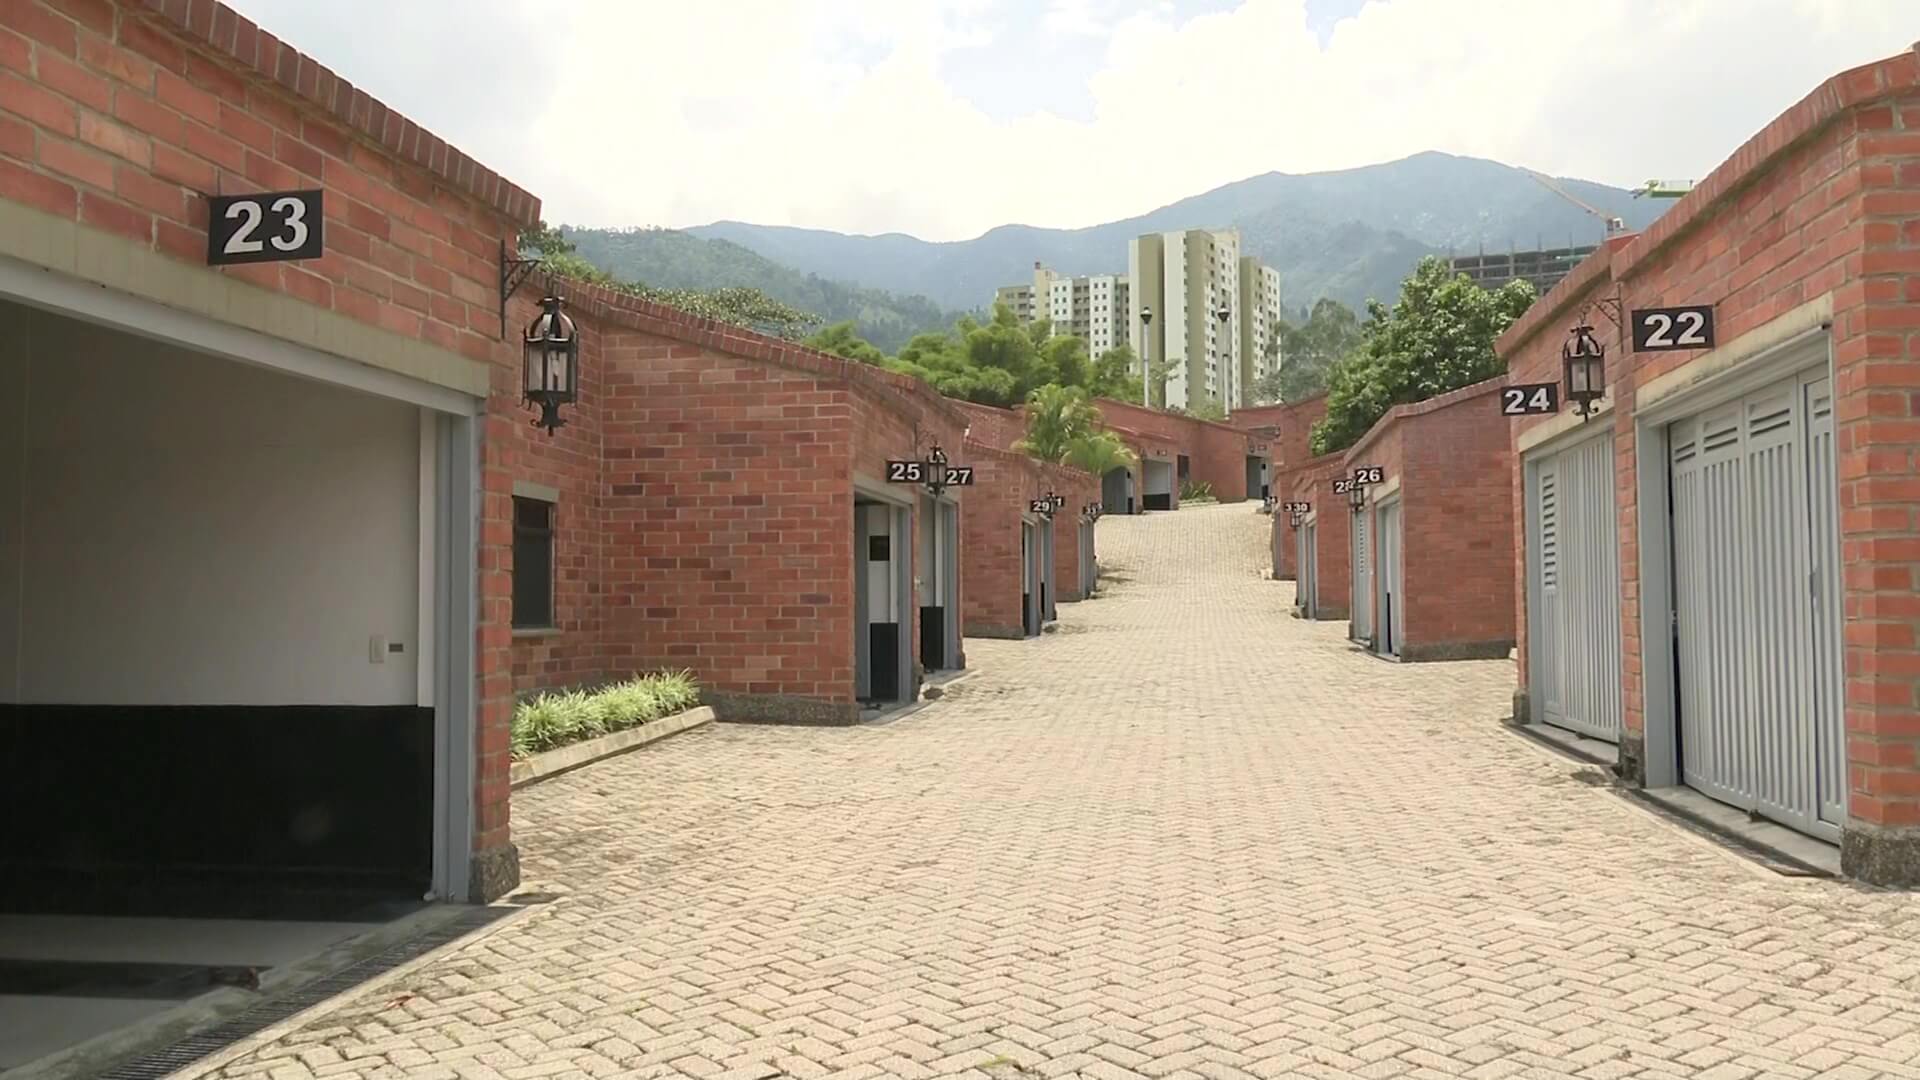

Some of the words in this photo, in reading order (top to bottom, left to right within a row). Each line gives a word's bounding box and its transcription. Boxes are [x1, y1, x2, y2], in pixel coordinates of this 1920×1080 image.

[224, 197, 308, 253] 23
[1644, 311, 1705, 347] 22
[1505, 387, 1550, 413] 24
[891, 463, 920, 480] 25
[946, 469, 971, 484] 27
[1357, 469, 1380, 482] 26
[1033, 501, 1049, 511] 29
